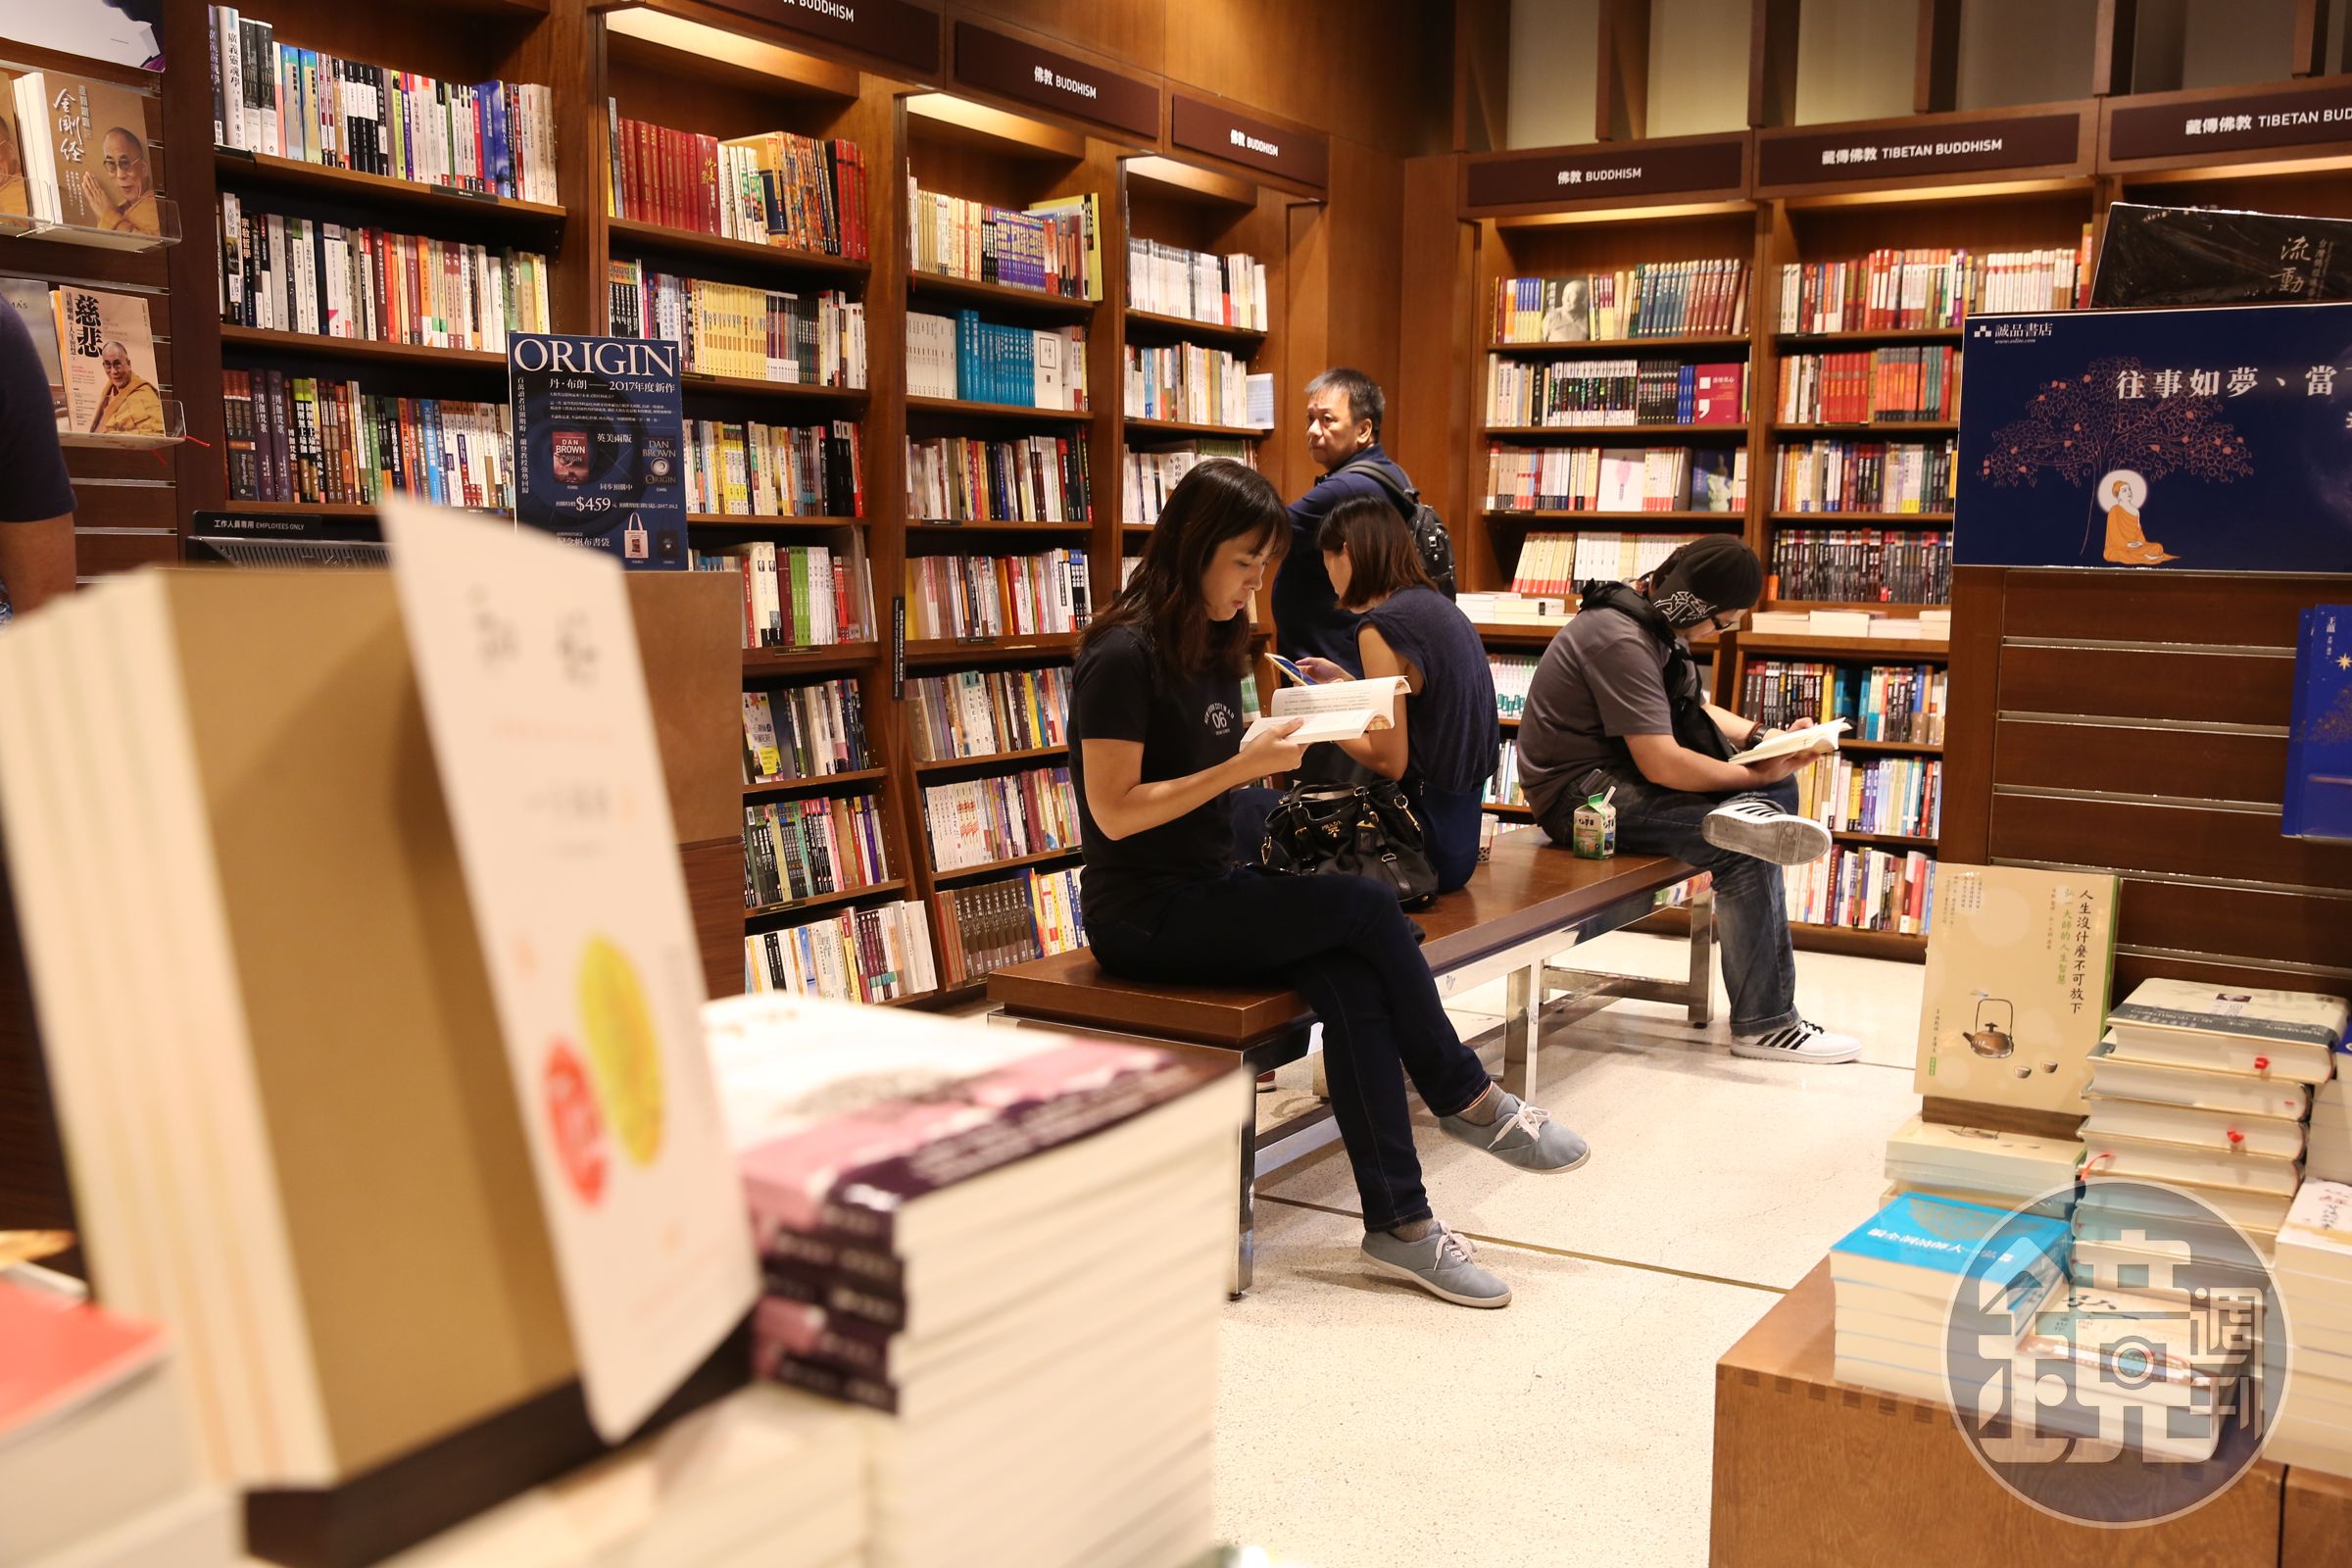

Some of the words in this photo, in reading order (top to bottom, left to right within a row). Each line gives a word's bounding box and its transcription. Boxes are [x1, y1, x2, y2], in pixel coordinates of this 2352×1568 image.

[799, 0, 855, 23] BUDDHISM
[1034, 66, 1054, 86] 佛教
[1055, 74, 1097, 99] BUDDHISM
[2184, 115, 2252, 135] 藏傳佛教
[2258, 111, 2319, 127] TIBETAN
[1247, 136, 1279, 157] BUDDHISM
[1822, 147, 1878, 166] 藏傳佛教
[1882, 143, 1933, 160] TIBETAN
[1936, 138, 2003, 156] BUDDHISM
[1557, 170, 1582, 185] 佛教
[1585, 167, 1642, 182] BUDDHISM
[2269, 235, 2312, 293] 流動
[74, 293, 103, 358] 慈悲
[1994, 322, 2053, 338] 誠品書店
[514, 338, 676, 377] ORIGIN
[609, 381, 675, 393] 2017年度新作
[2116, 365, 2352, 399] 往事如夢、當
[642, 449, 676, 458] BROWN
[648, 440, 669, 449] DAN
[645, 474, 676, 484] ORIGIN
[575, 495, 612, 512] $459
[214, 519, 255, 529] 工作人員專用
[256, 521, 289, 530] EMPLOYEES
[1211, 710, 1227, 728] 06
[2069, 889, 2094, 1015] 人生沒什麼不可放下
